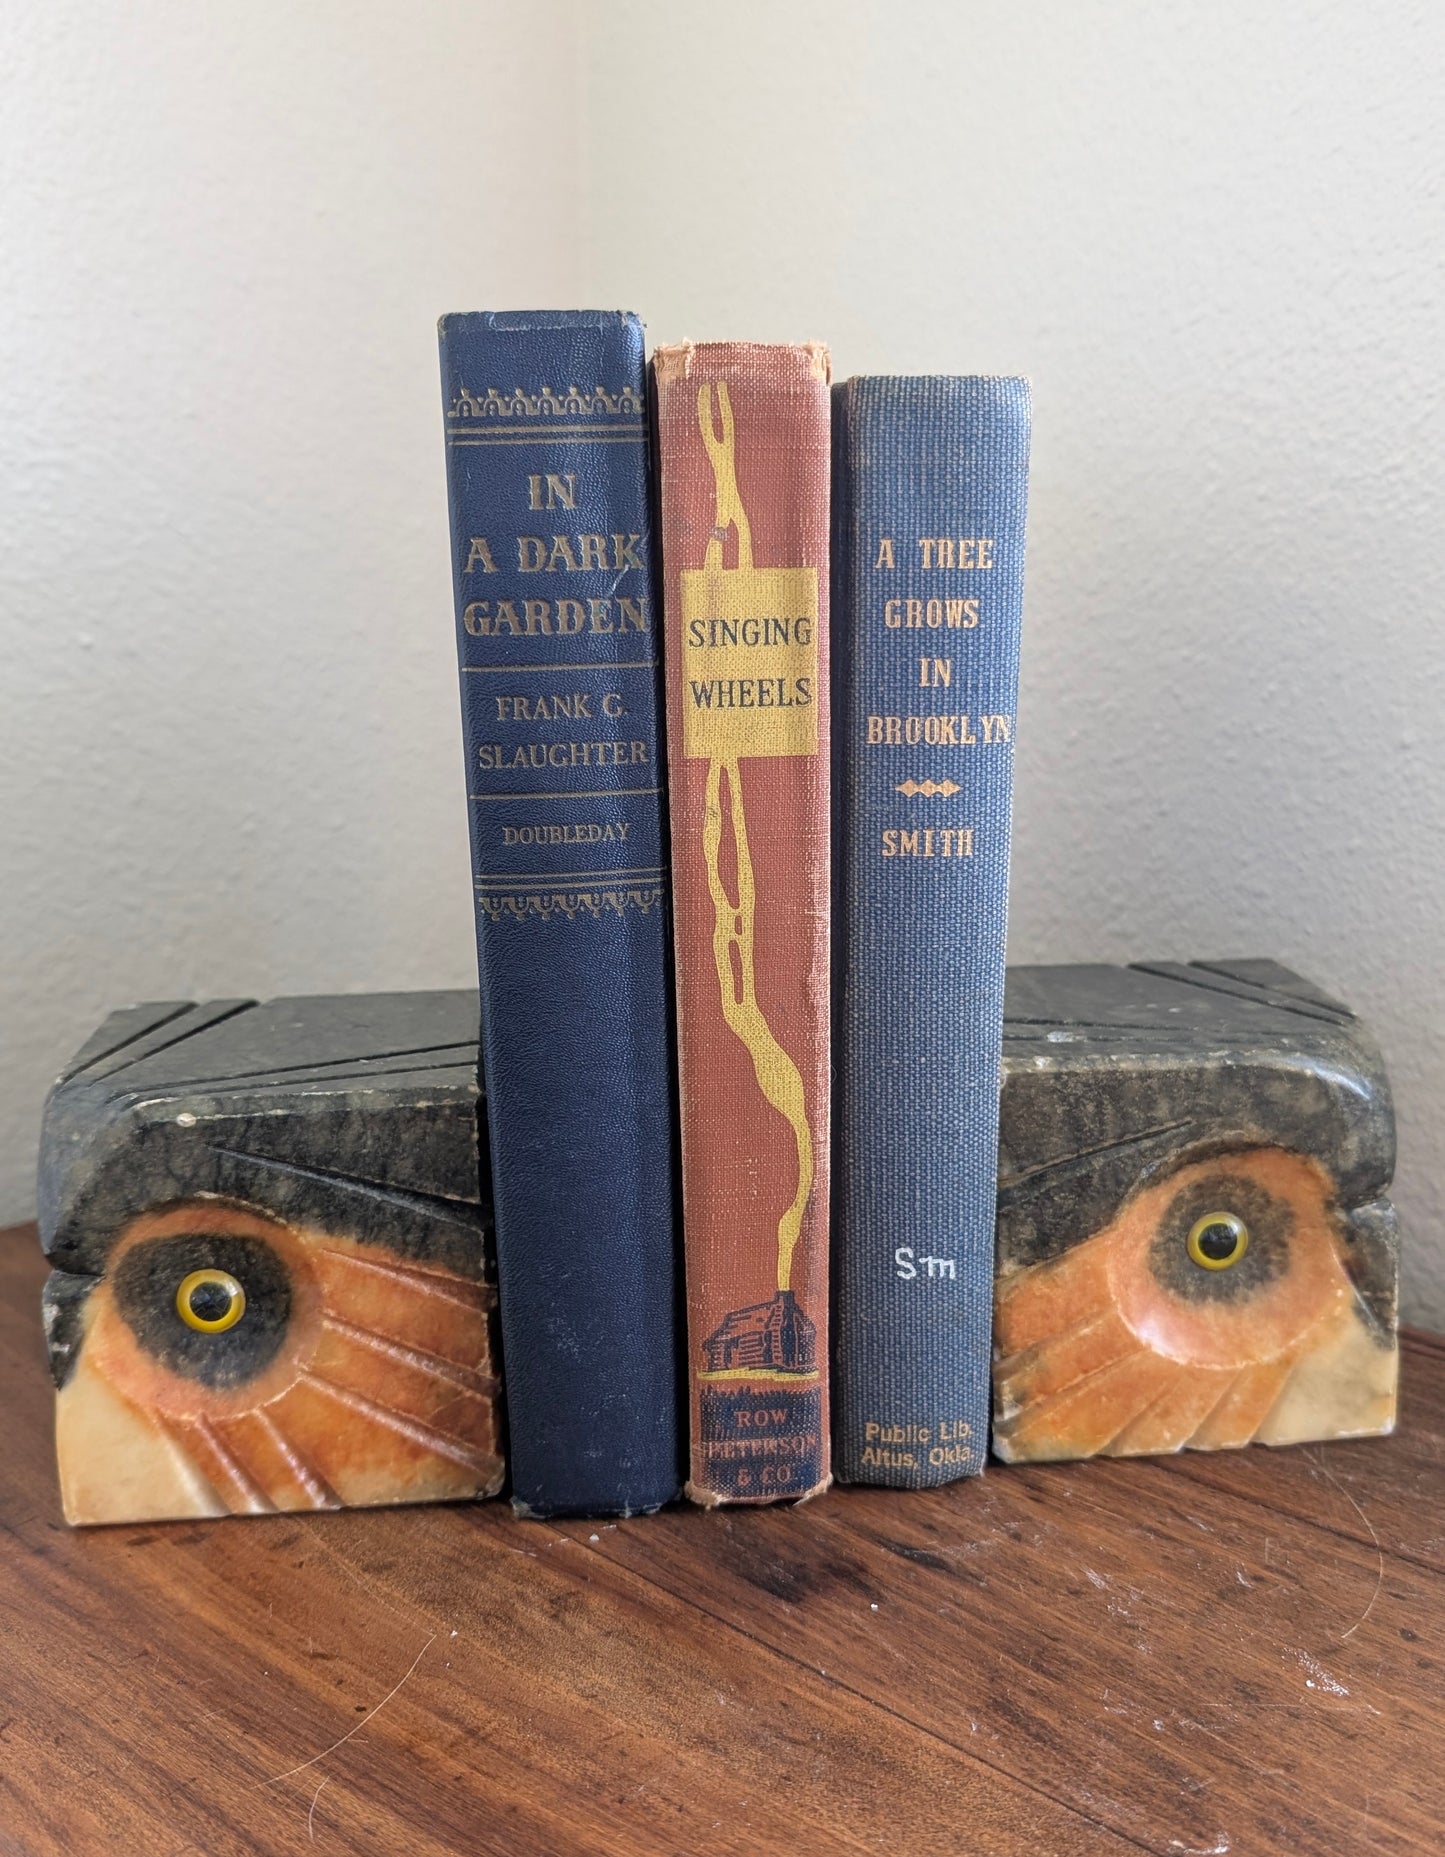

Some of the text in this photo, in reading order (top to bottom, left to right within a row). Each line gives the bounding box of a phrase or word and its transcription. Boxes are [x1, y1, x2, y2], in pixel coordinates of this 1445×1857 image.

[528, 473, 577, 510] IN
[463, 533, 646, 573] A DARK
[875, 538, 993, 569] A TREE
[463, 597, 650, 636] GARDEN
[884, 599, 980, 629] GROWS
[688, 617, 812, 648] SINGING
[918, 657, 951, 688] IN
[495, 694, 592, 721] FRANK
[688, 677, 813, 709] WHEELS
[866, 715, 1012, 745] BROOKLYN
[478, 740, 649, 770] SLAUGHTER
[502, 822, 631, 846] DOUBLEDAY
[881, 828, 975, 858] SMITH
[734, 1408, 788, 1428] ROW
[865, 1421, 931, 1443] Public
[861, 1444, 975, 1470] Altus, Okla.
[736, 1468, 752, 1488] &
